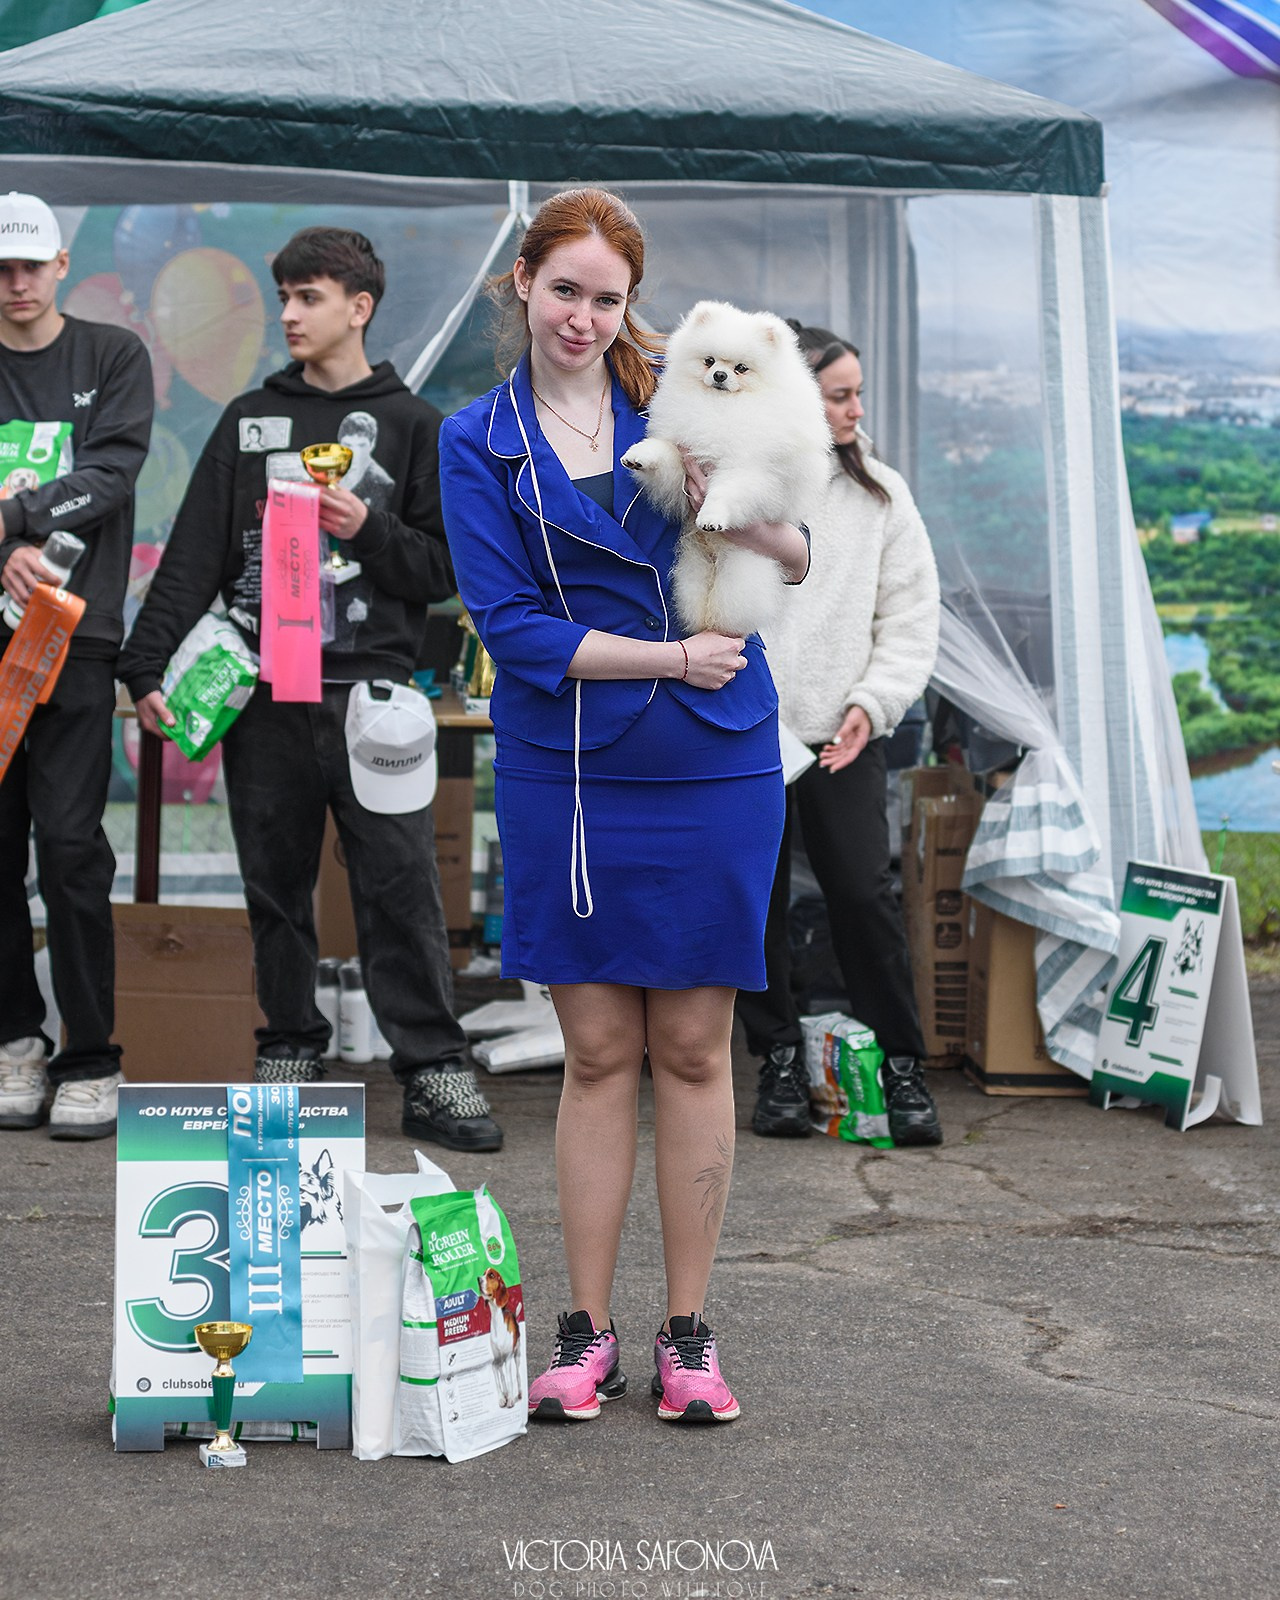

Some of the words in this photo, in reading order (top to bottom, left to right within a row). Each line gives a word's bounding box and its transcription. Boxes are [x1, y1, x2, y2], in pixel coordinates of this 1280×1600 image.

[1, 222, 39, 235] ИЛЛИ
[290, 536, 301, 598] МЕСТО
[1106, 934, 1168, 1048] 4
[139, 1107, 167, 1116] «ОО
[171, 1107, 213, 1116] КЛУБ
[232, 1086, 252, 1138] ПО
[183, 1120, 228, 1130] ЕВРЕЙ
[256, 1170, 273, 1254] МЕСТО
[434, 1228, 470, 1251] GREEN
[432, 1243, 477, 1266] HOLDER
[126, 1181, 230, 1353] 3
[443, 1294, 466, 1310] ADULT
[443, 1314, 470, 1329] MEDIUM
[444, 1324, 468, 1337] BREEDS
